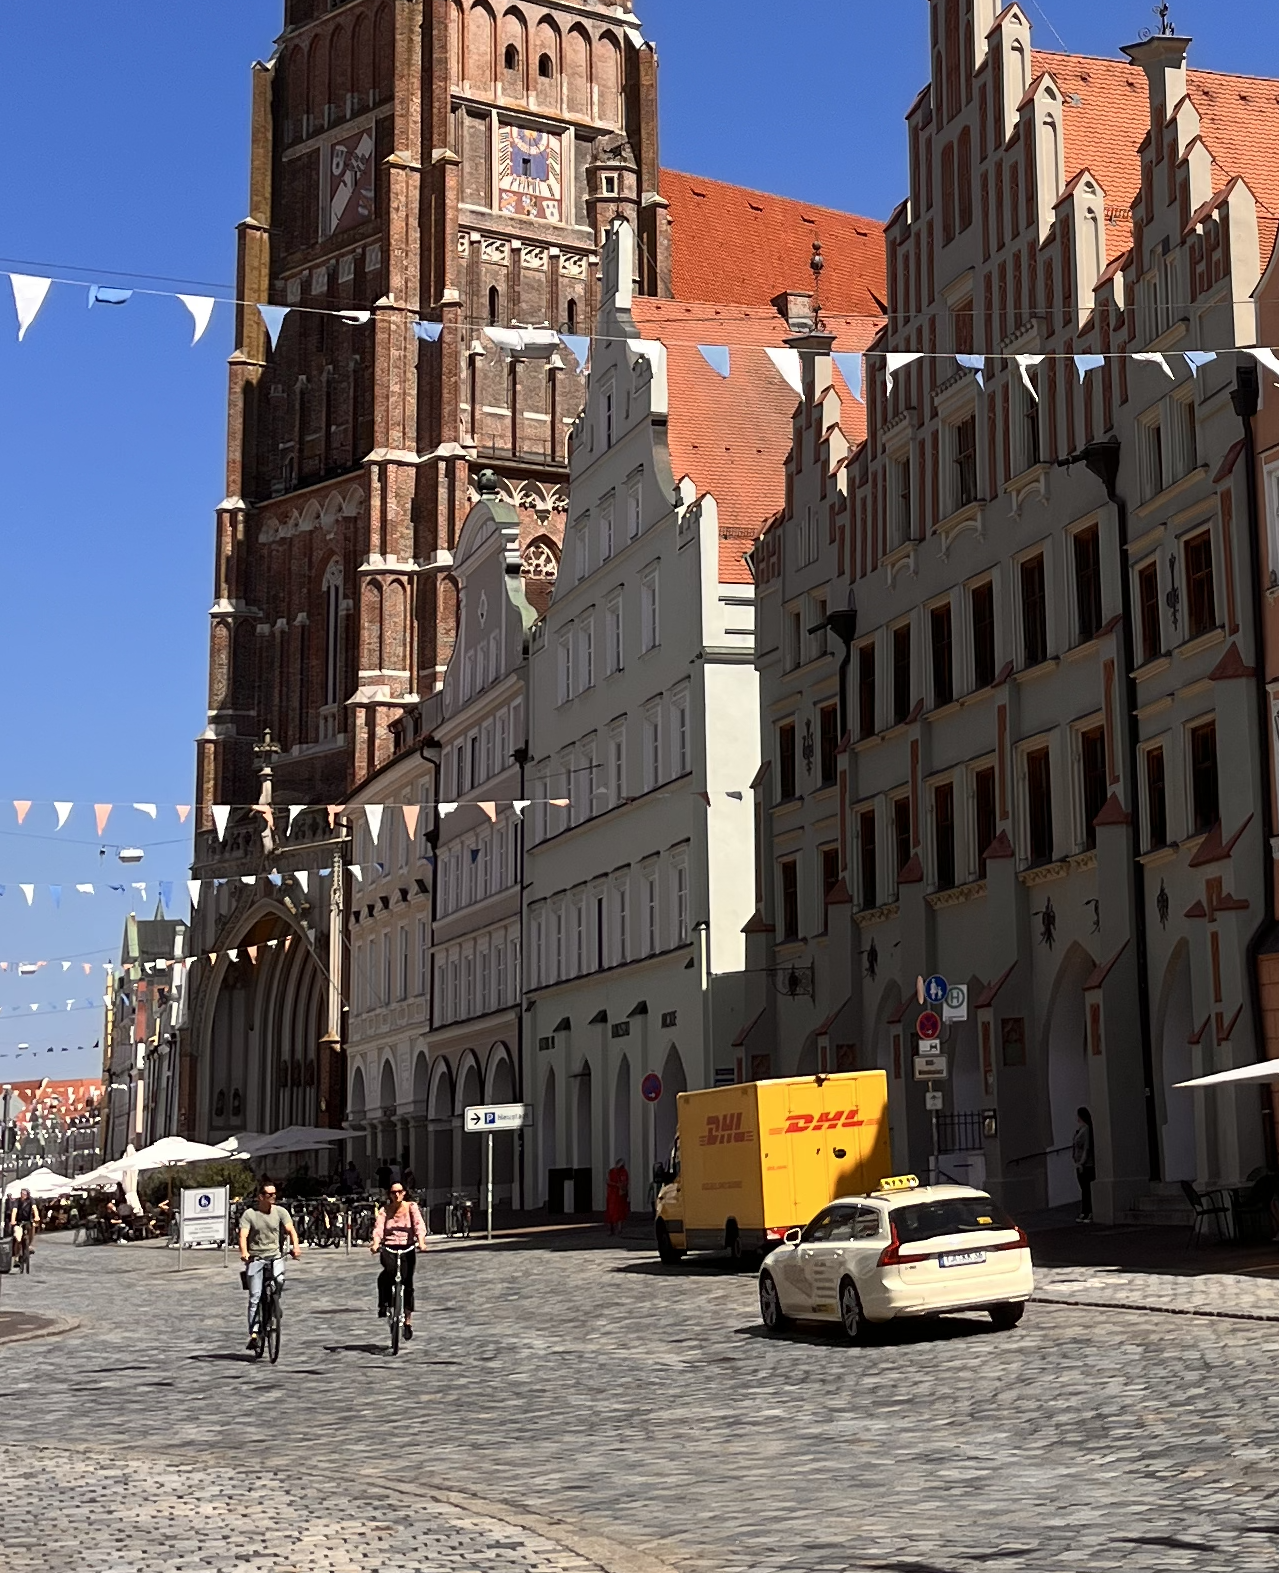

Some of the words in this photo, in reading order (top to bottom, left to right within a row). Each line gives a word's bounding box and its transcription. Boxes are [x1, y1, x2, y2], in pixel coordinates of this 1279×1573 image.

[950, 990, 960, 1004] H
[701, 1112, 748, 1146] DHL
[785, 1109, 864, 1134] DHL
